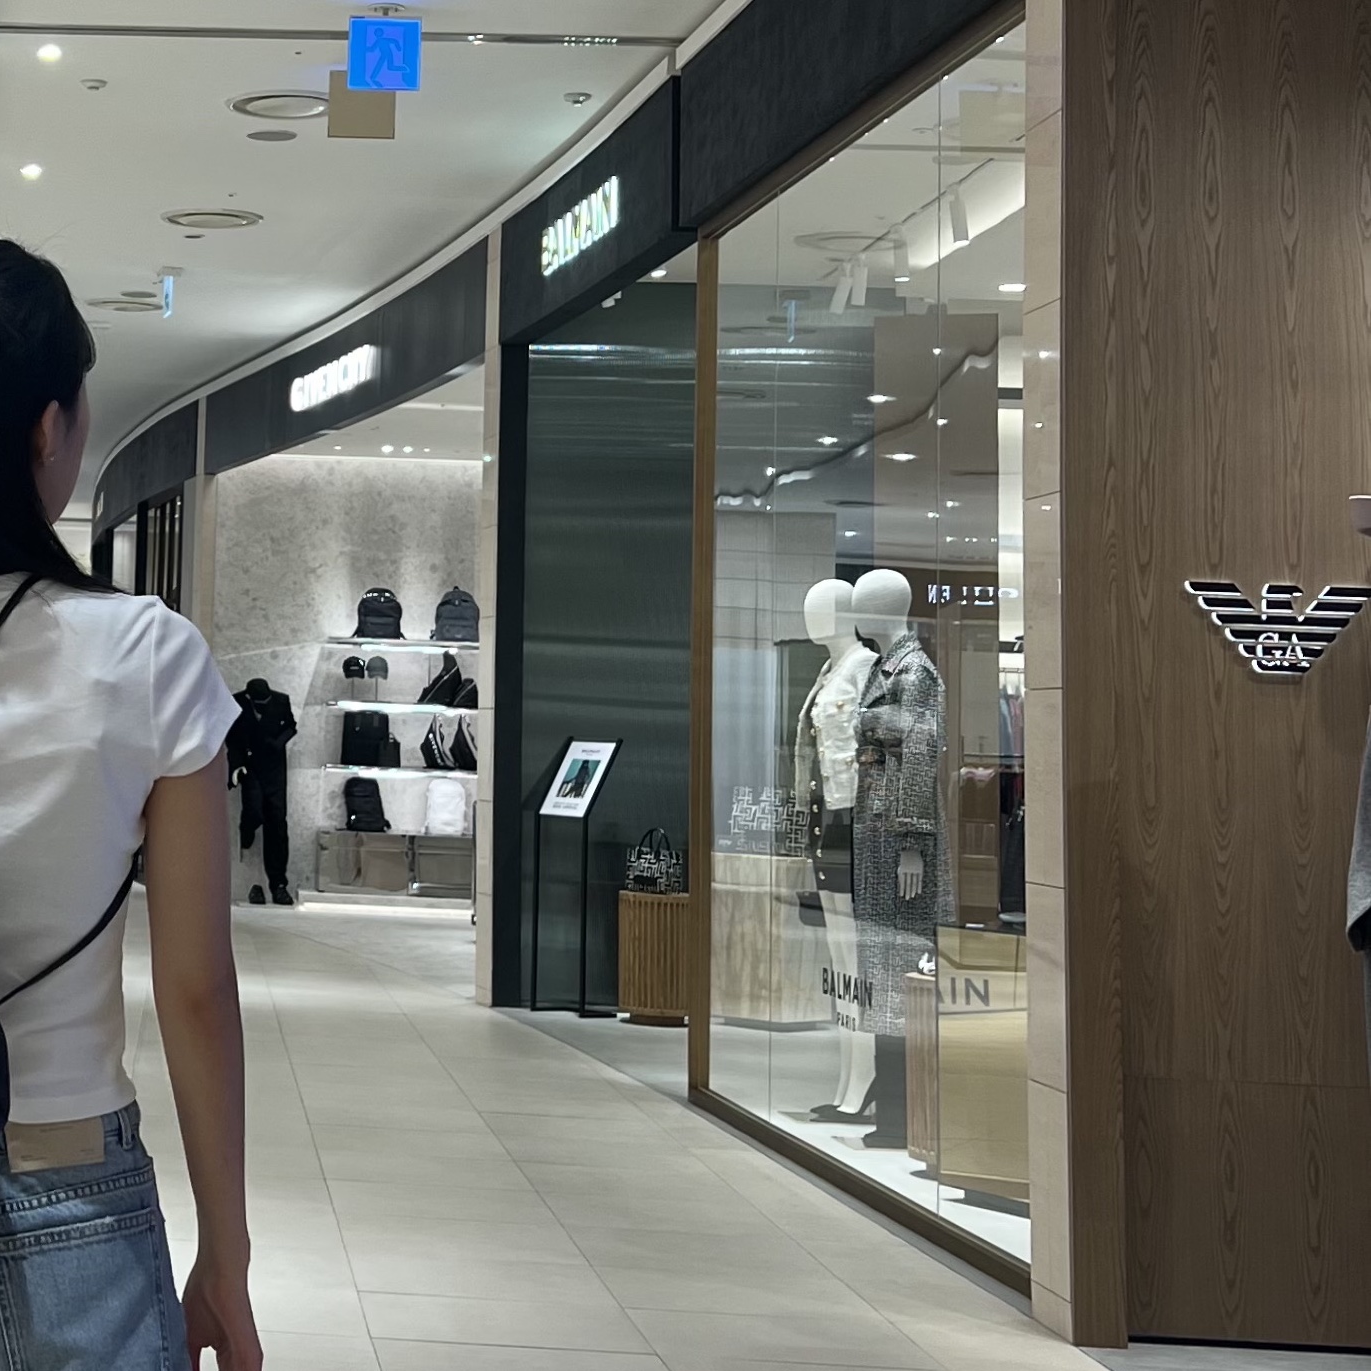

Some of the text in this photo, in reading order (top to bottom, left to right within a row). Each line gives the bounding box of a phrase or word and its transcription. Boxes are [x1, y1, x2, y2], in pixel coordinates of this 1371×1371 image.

[541, 174, 619, 276] BALMAIN
[1255, 632, 1311, 667] GA
[821, 966, 873, 1010] BALMAIN
[836, 1012, 856, 1032] PARIS
